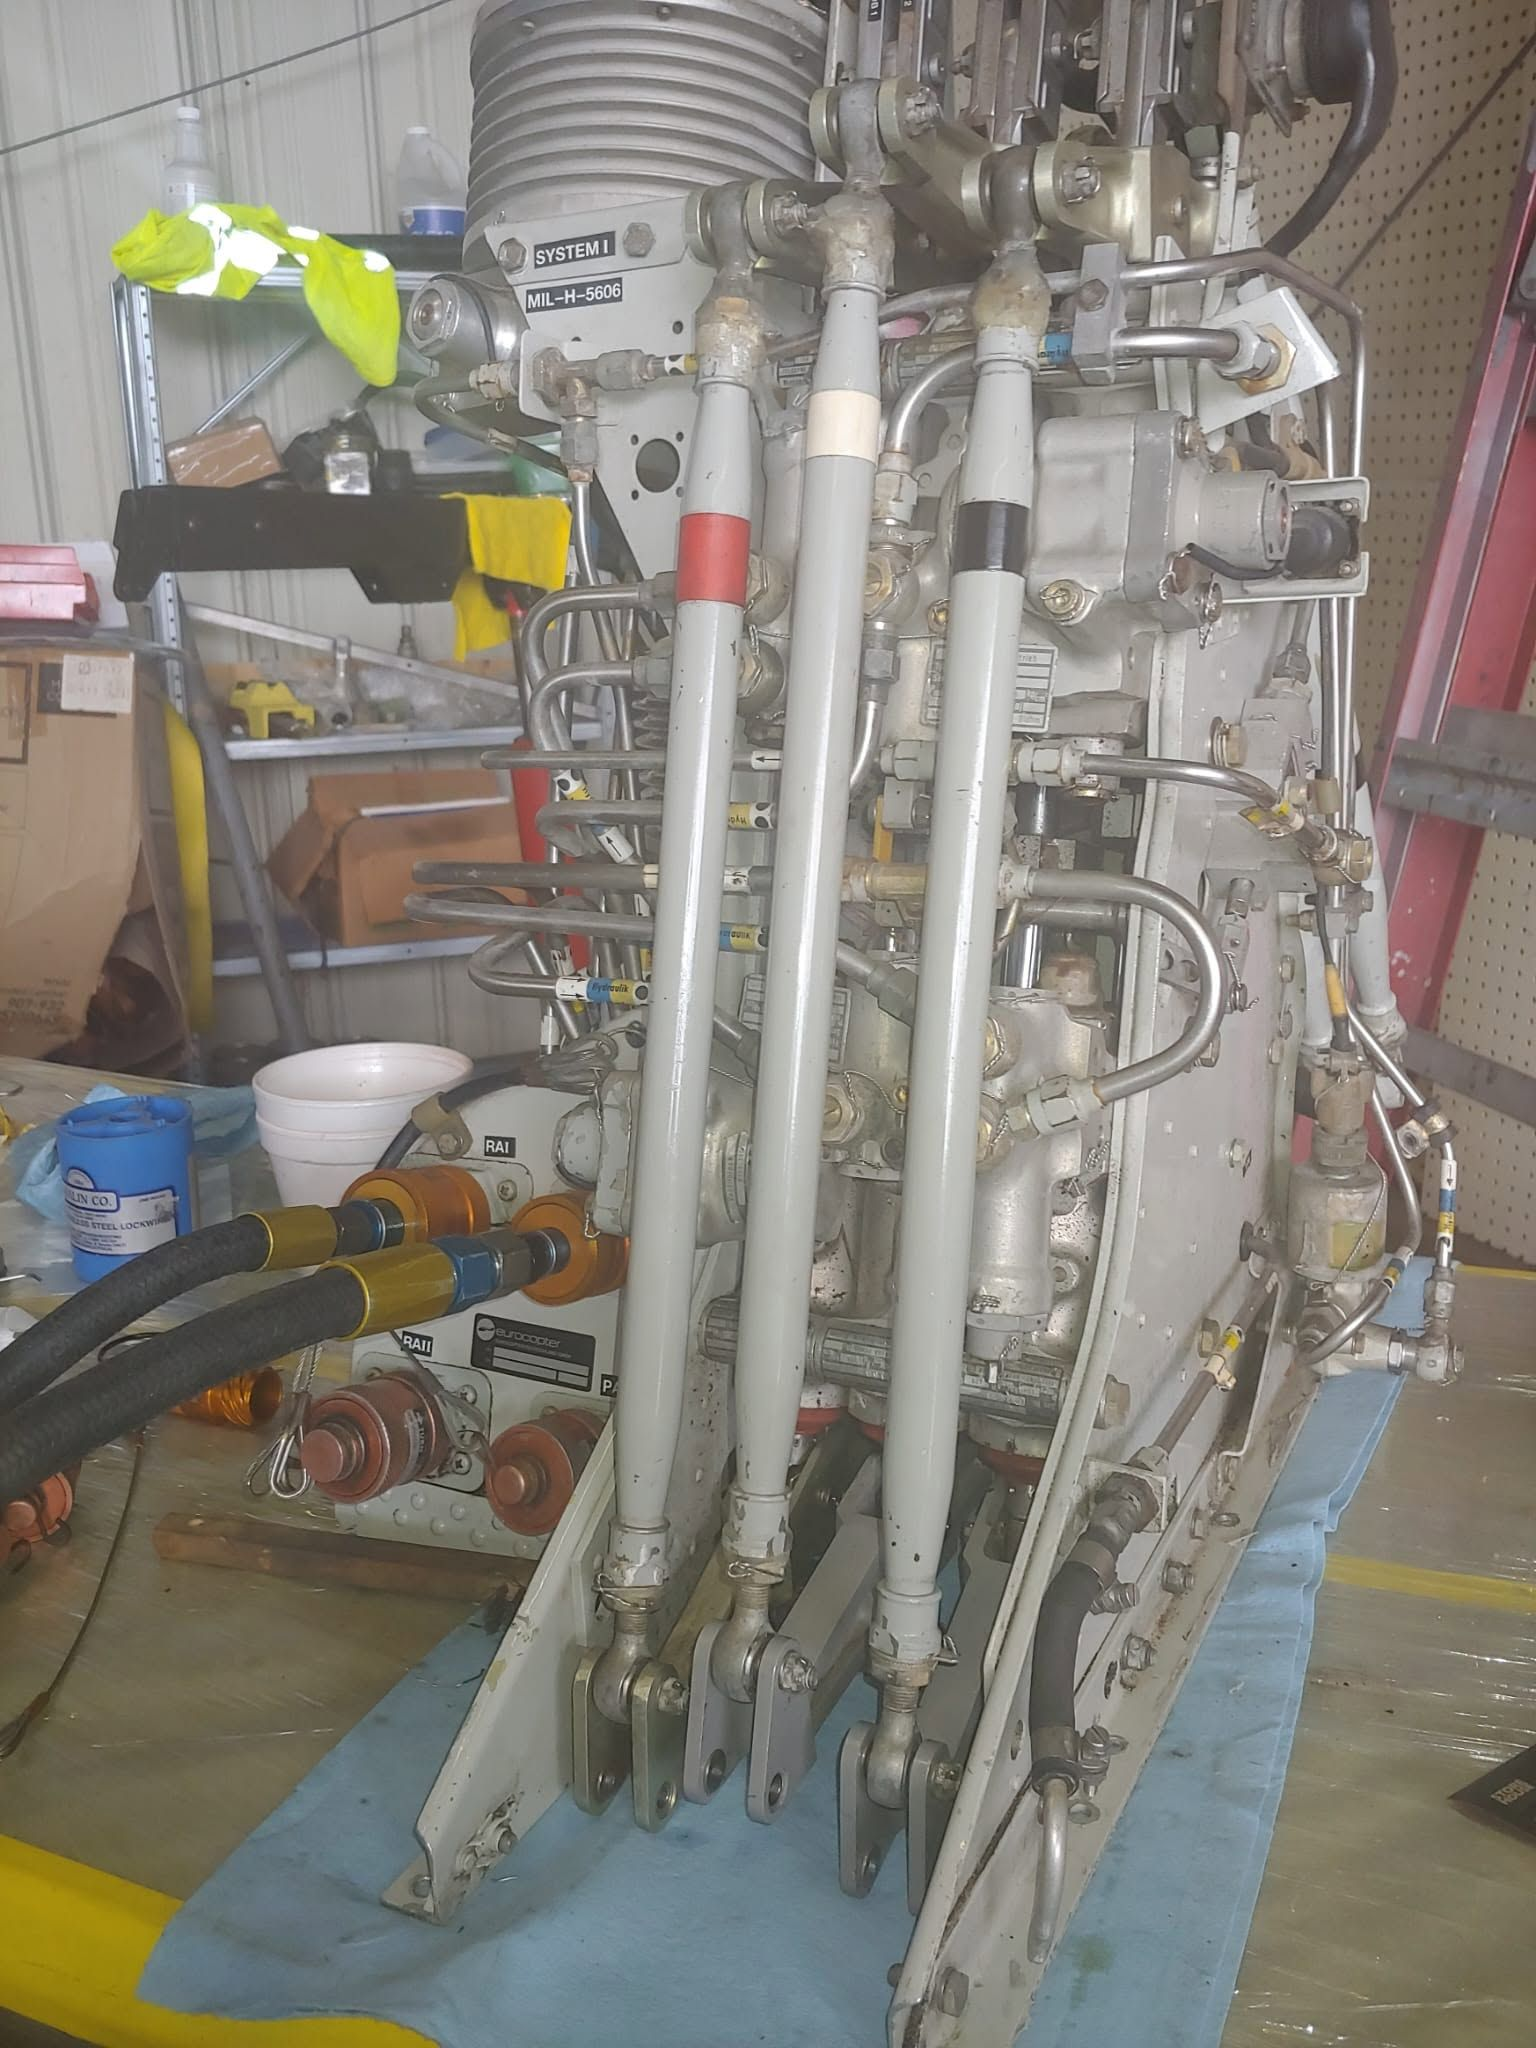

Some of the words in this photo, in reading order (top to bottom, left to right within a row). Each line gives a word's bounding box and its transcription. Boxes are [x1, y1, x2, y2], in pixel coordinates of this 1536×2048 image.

[535, 240, 600, 265] SYSTEM
[602, 239, 609, 254] I
[526, 283, 622, 309] MIL-H-5606
[591, 983, 630, 994] Hydraulik
[485, 1139, 510, 1154] RAI
[91, 1195, 113, 1207] CO.
[91, 1221, 119, 1231] STEEL
[403, 1335, 431, 1353] RAII
[495, 1327, 561, 1348] eurocopter
